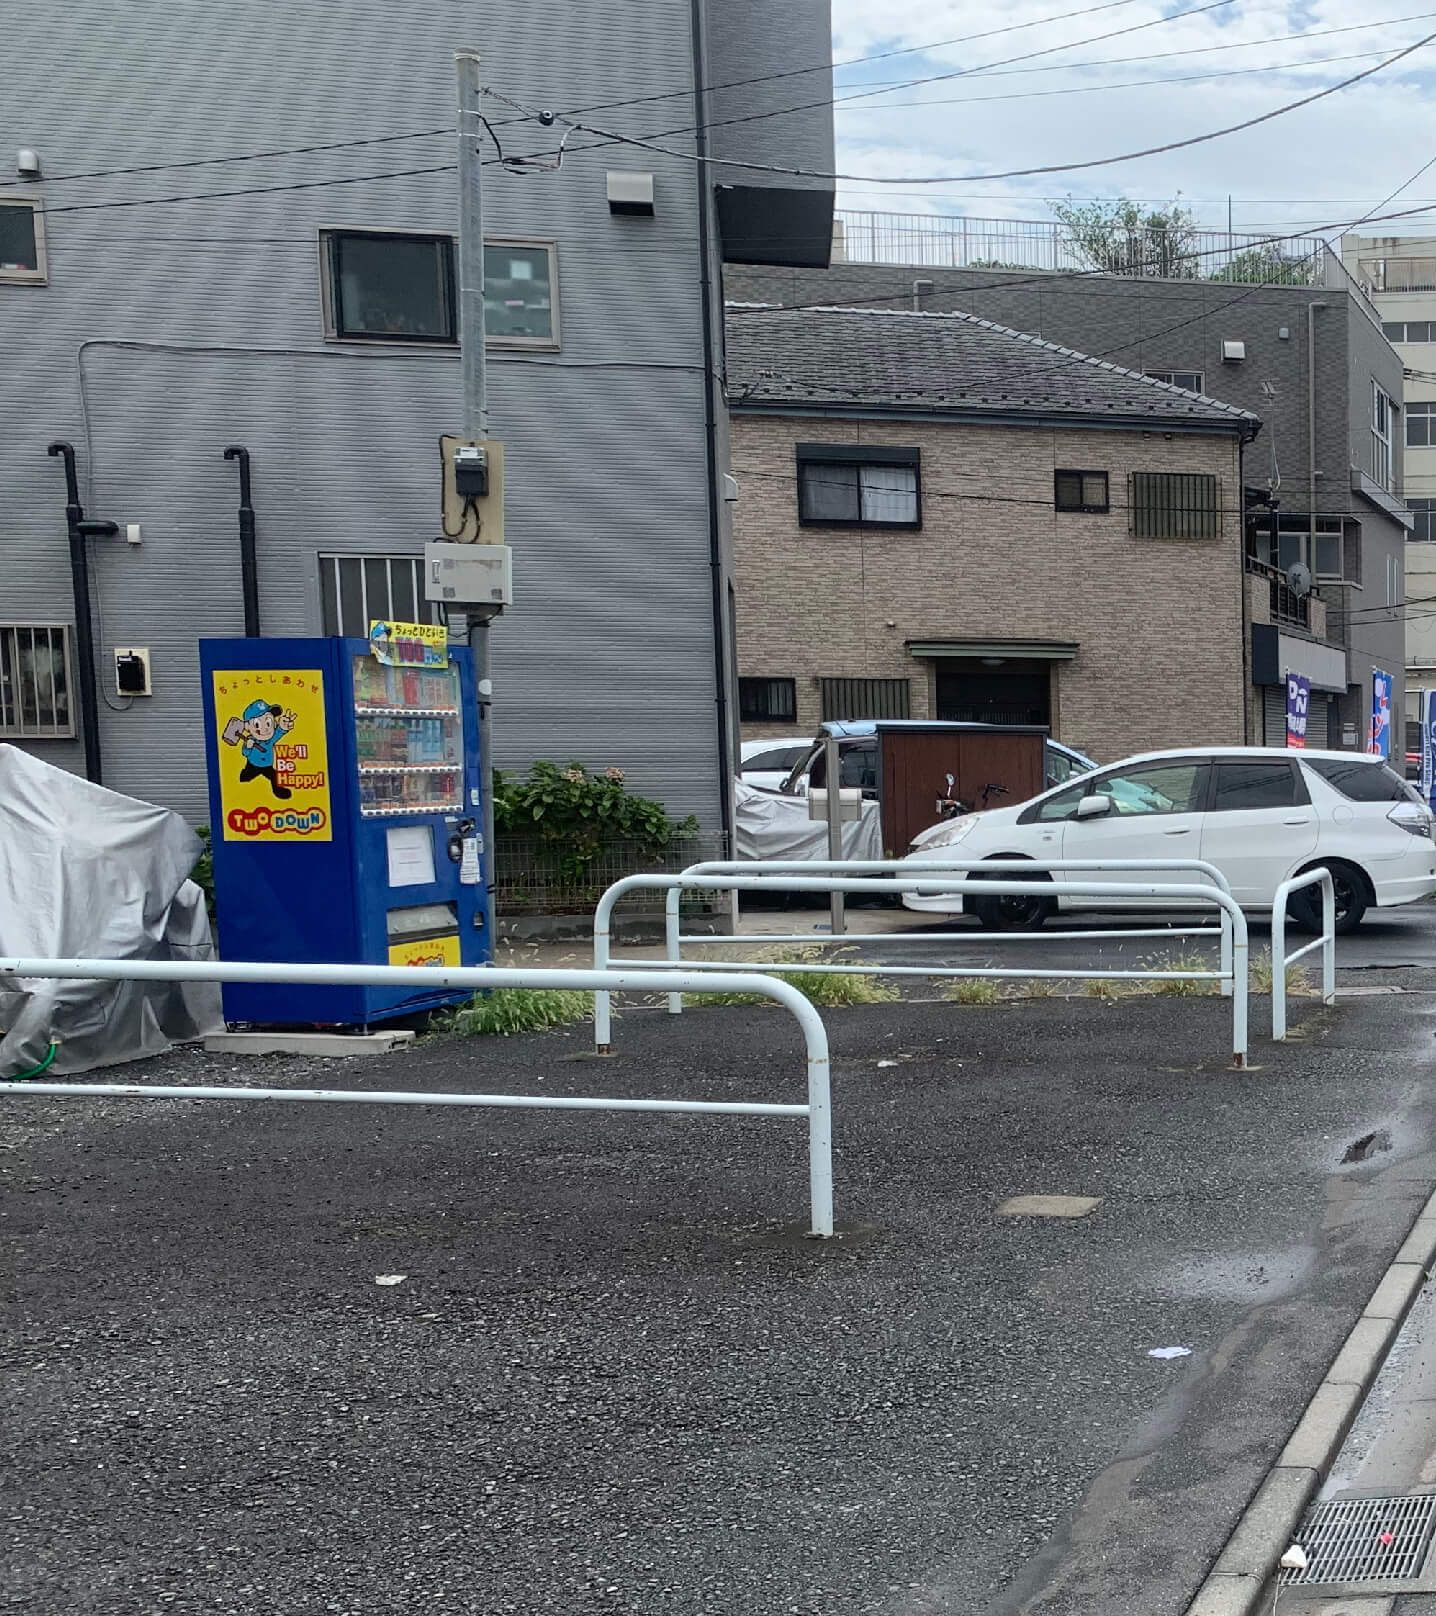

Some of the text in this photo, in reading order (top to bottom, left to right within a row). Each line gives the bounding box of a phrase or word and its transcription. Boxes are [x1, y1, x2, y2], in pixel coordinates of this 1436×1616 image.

[219, 674, 319, 695] ちょっとしあわせ
[275, 745, 307, 759] We'll
[277, 759, 295, 772] Be
[277, 771, 324, 788] Happy!
[232, 812, 320, 831] TWO DOWN
